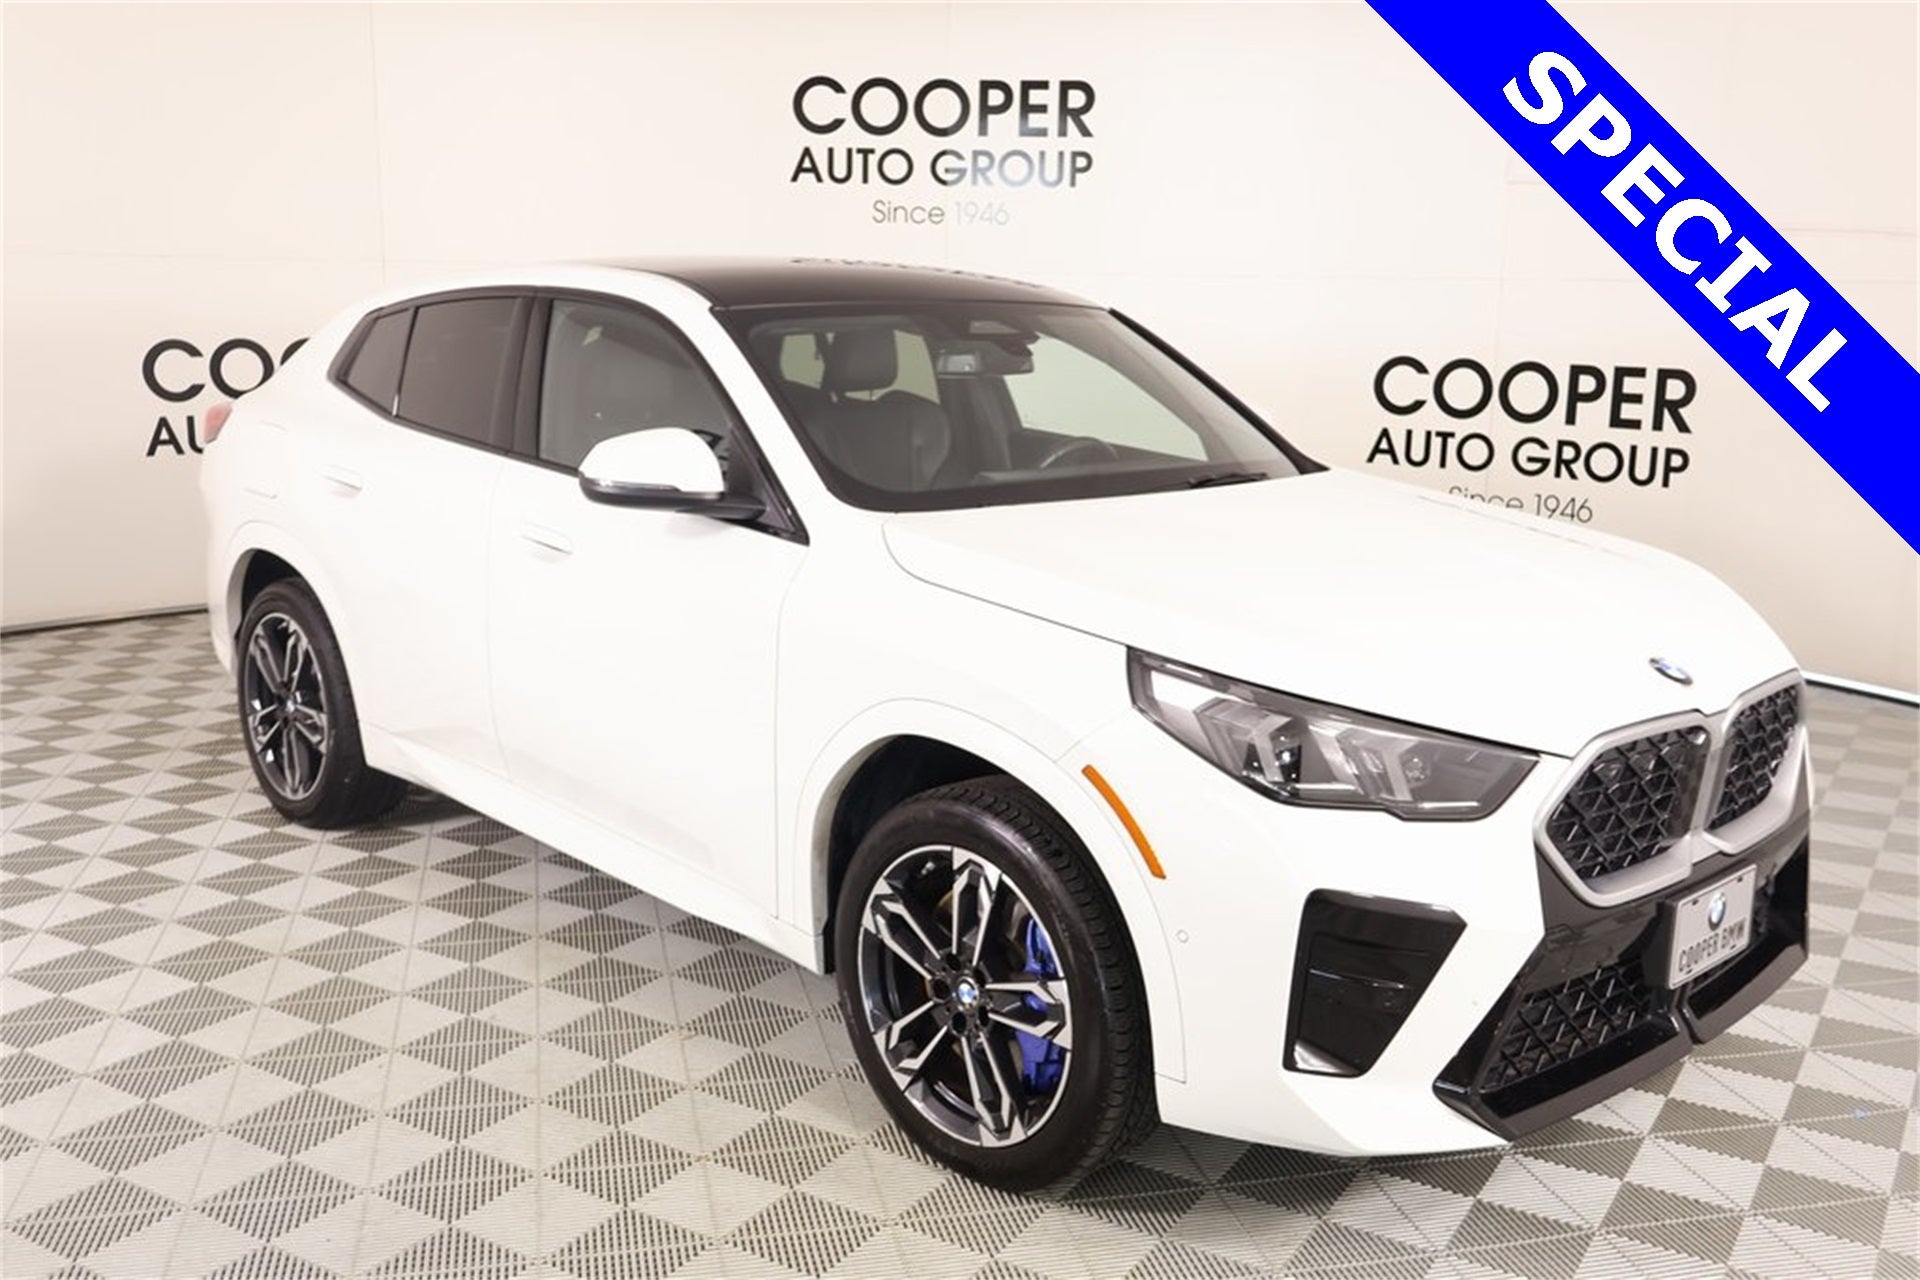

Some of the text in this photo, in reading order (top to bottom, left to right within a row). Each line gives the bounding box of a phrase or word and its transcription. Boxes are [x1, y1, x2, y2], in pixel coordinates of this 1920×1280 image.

[792, 75, 1096, 138] COOPER
[789, 146, 1094, 189] AUTO GROUP
[871, 199, 1011, 227] Since 1946
[141, 337, 310, 403] CO
[1373, 355, 1697, 434] COOPER
[1366, 427, 1691, 489] AUTO GROUP
[1534, 492, 1594, 525] 1946
[1678, 917, 1747, 973] COOPER BMW
